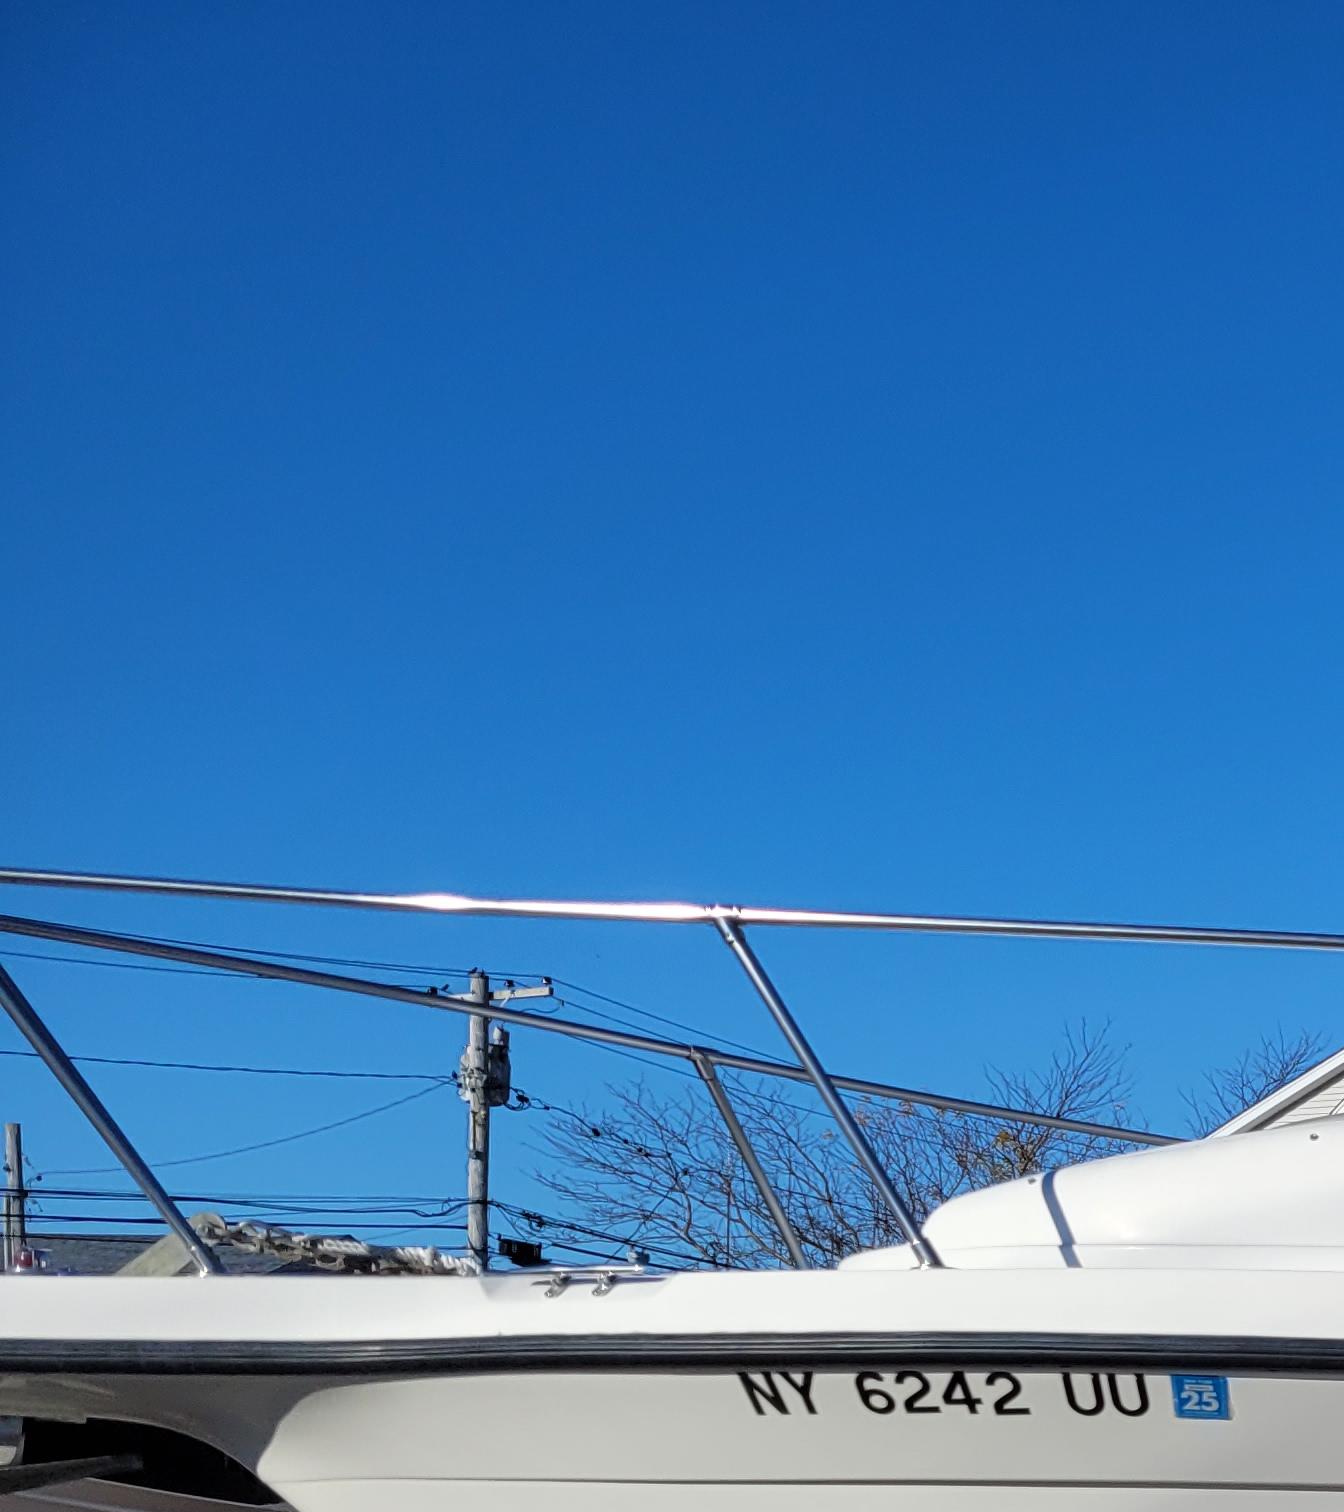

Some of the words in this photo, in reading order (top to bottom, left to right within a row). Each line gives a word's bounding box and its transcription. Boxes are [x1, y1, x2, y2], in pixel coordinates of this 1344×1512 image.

[737, 1371, 819, 1416] NY
[855, 1370, 1032, 1415] 6242
[1061, 1372, 1151, 1417] UU
[1181, 1390, 1220, 1411] 25
